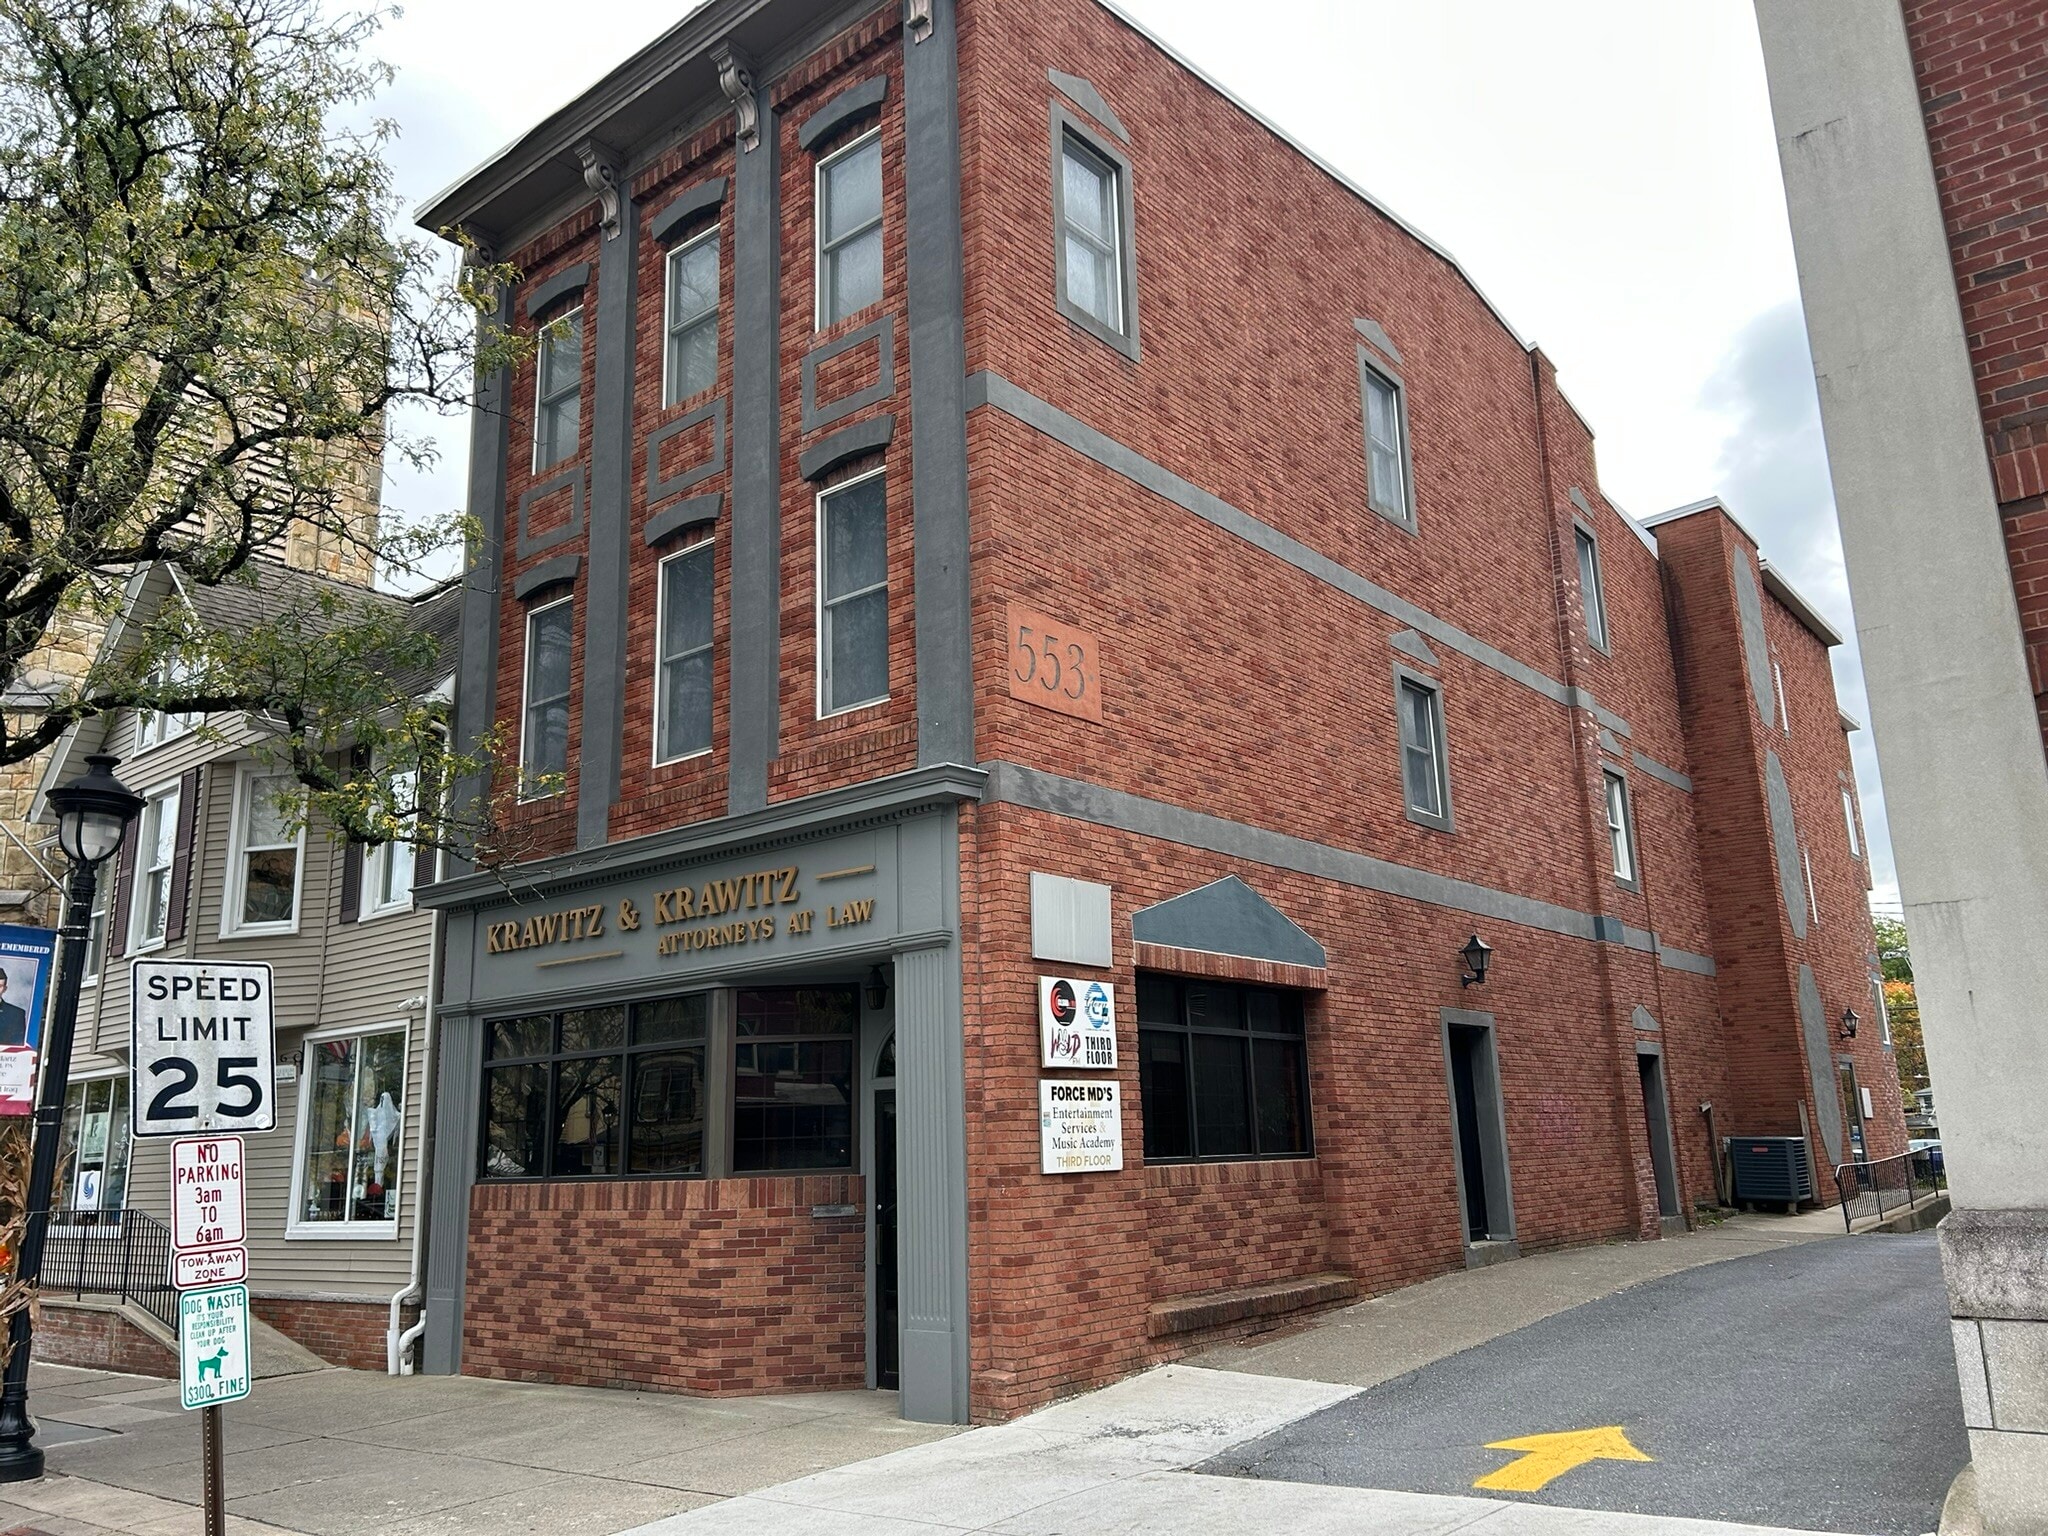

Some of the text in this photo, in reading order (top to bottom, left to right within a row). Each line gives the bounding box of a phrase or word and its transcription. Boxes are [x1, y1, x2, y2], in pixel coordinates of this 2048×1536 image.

[1015, 626, 1085, 699] 553
[486, 866, 799, 954] KRAWITZ & KRAWITZ
[657, 898, 875, 956] ATTORNEYS AT LAW
[0, 942, 50, 954] EMEMBERED
[147, 975, 261, 1001] SPEED
[158, 1017, 251, 1041] LIMIT
[1085, 1036, 1112, 1051] THIRD
[1086, 1051, 1113, 1065] FLOOR
[146, 1056, 263, 1121] 25
[1051, 1086, 1113, 1102] FORCE MD'S
[1052, 1107, 1113, 1119] Entertainment
[1061, 1121, 1098, 1134] Services
[1052, 1135, 1116, 1152] Music Academy
[197, 1143, 219, 1163] NO
[1057, 1155, 1112, 1167] THIRD FLOOR
[178, 1163, 239, 1184] PARKING
[195, 1187, 222, 1204] 3am
[201, 1206, 217, 1223] TO
[196, 1225, 223, 1243] 6am
[181, 1253, 241, 1268] TOW-AWAY
[195, 1268, 225, 1279] ZONE
[184, 1292, 243, 1315] DOG WASTE
[192, 1317, 234, 1330] RESPONSIBILITY
[207, 1311, 223, 1319] YOUR
[190, 1325, 236, 1339] CLEAN UP AFTER
[197, 1337, 225, 1348] YOUR DOG
[219, 1377, 245, 1395] FINE
